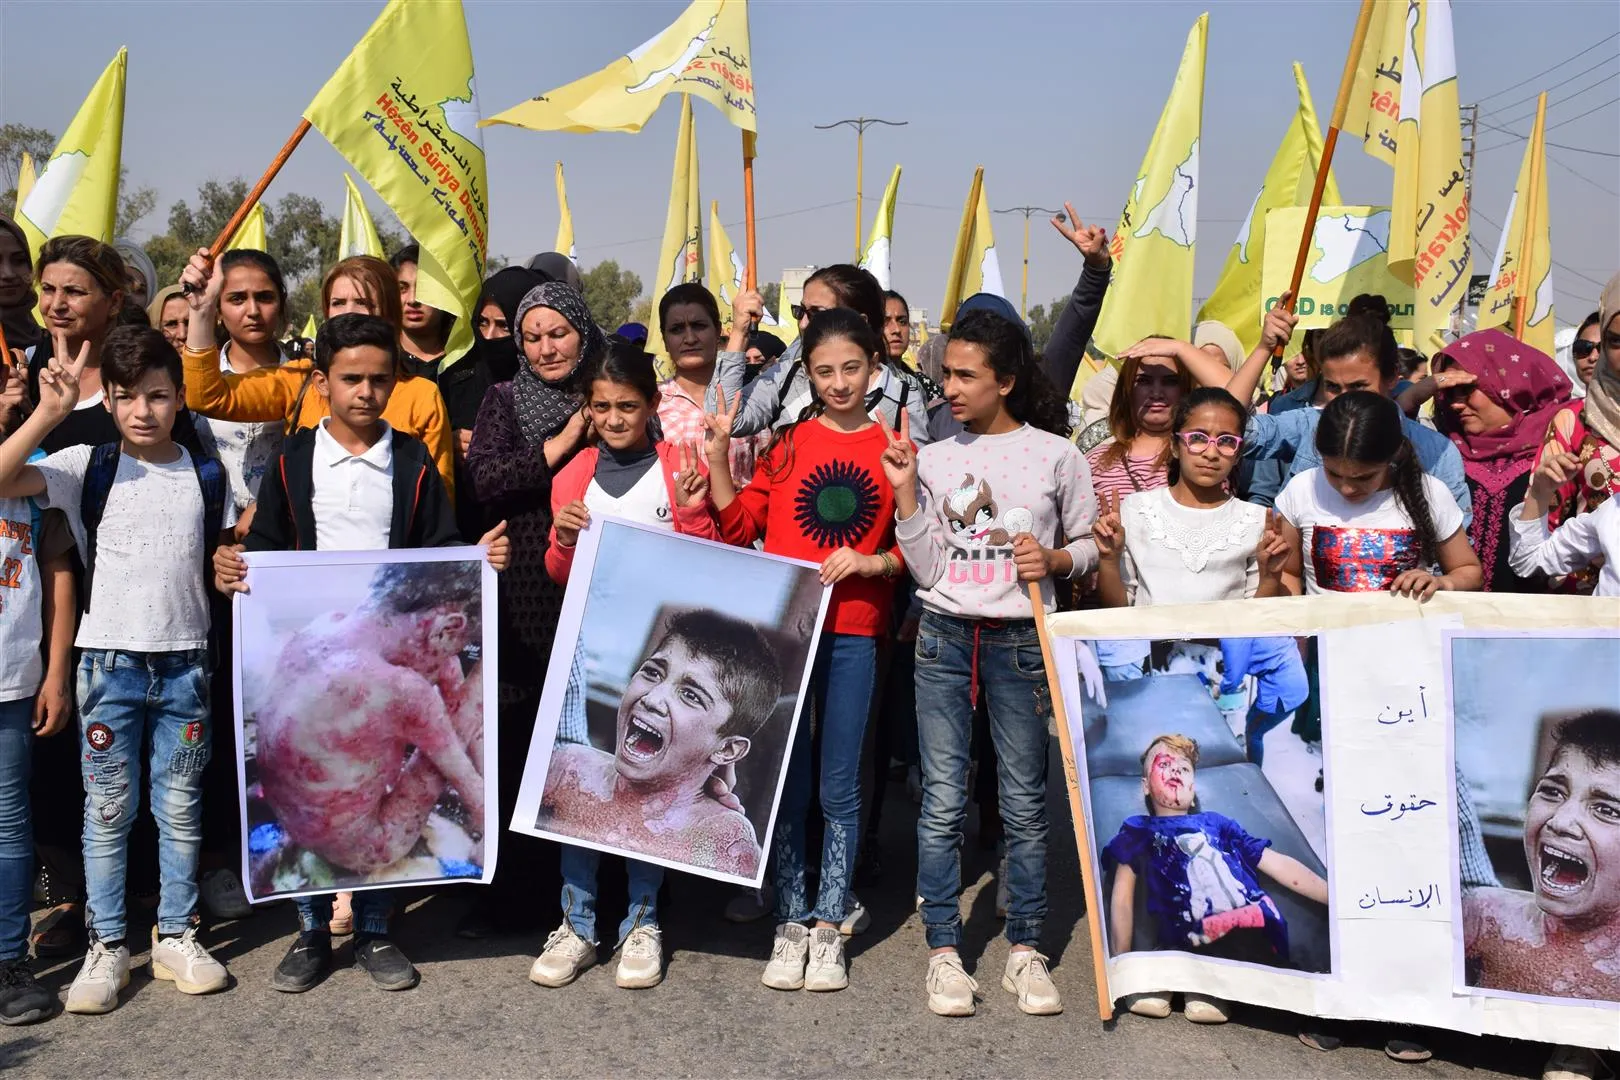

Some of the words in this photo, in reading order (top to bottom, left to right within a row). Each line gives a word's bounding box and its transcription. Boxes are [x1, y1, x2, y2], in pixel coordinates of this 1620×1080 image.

[374, 92, 419, 145] Hêzên
[418, 142, 461, 193] Sûriya
[949, 549, 1014, 583] CUT
[1319, 561, 1394, 588] LOV
[1377, 685, 1428, 725] أين
[1360, 794, 1437, 822] حقوق
